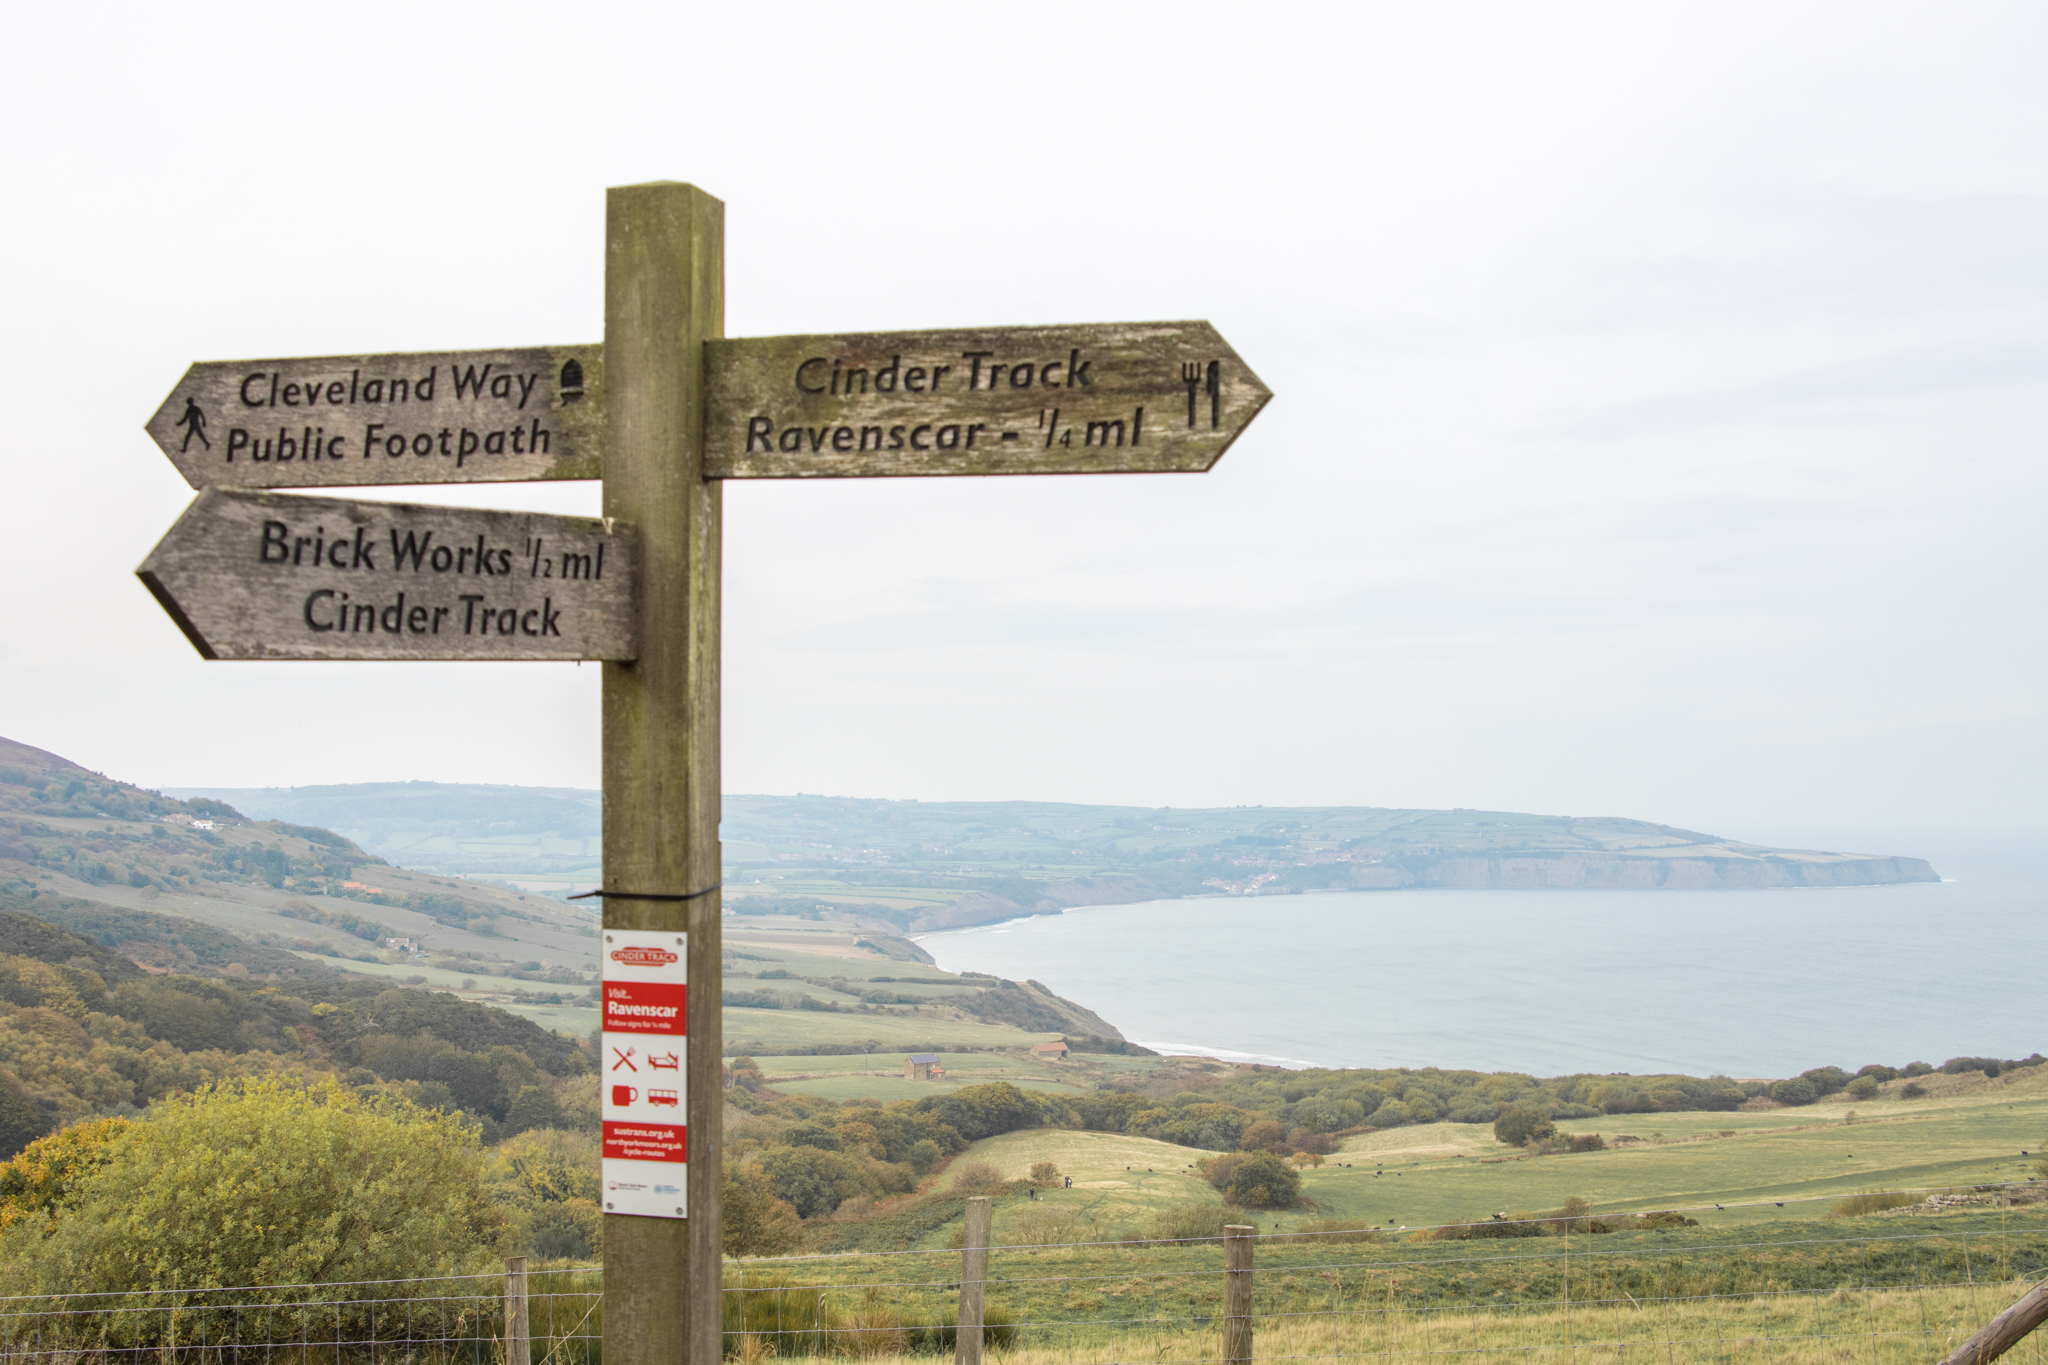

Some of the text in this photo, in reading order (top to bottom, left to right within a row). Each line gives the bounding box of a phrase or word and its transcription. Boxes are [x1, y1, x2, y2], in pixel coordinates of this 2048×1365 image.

[240, 364, 537, 408] Cleveland Way
[796, 349, 1093, 395] Cinder Track
[226, 418, 550, 467] Public Footpath
[745, 416, 985, 454] Ravenscar
[1085, 407, 1145, 448] ml
[259, 521, 376, 569] Brick
[390, 528, 512, 576] Works
[562, 543, 604, 580] ml
[304, 588, 561, 637] Cinder Track
[612, 951, 676, 962] CINDER TRACK
[608, 1001, 678, 1018] Ravenscar
[608, 1019, 626, 1027] Follow
[614, 1128, 674, 1139] sustrans.org.uk
